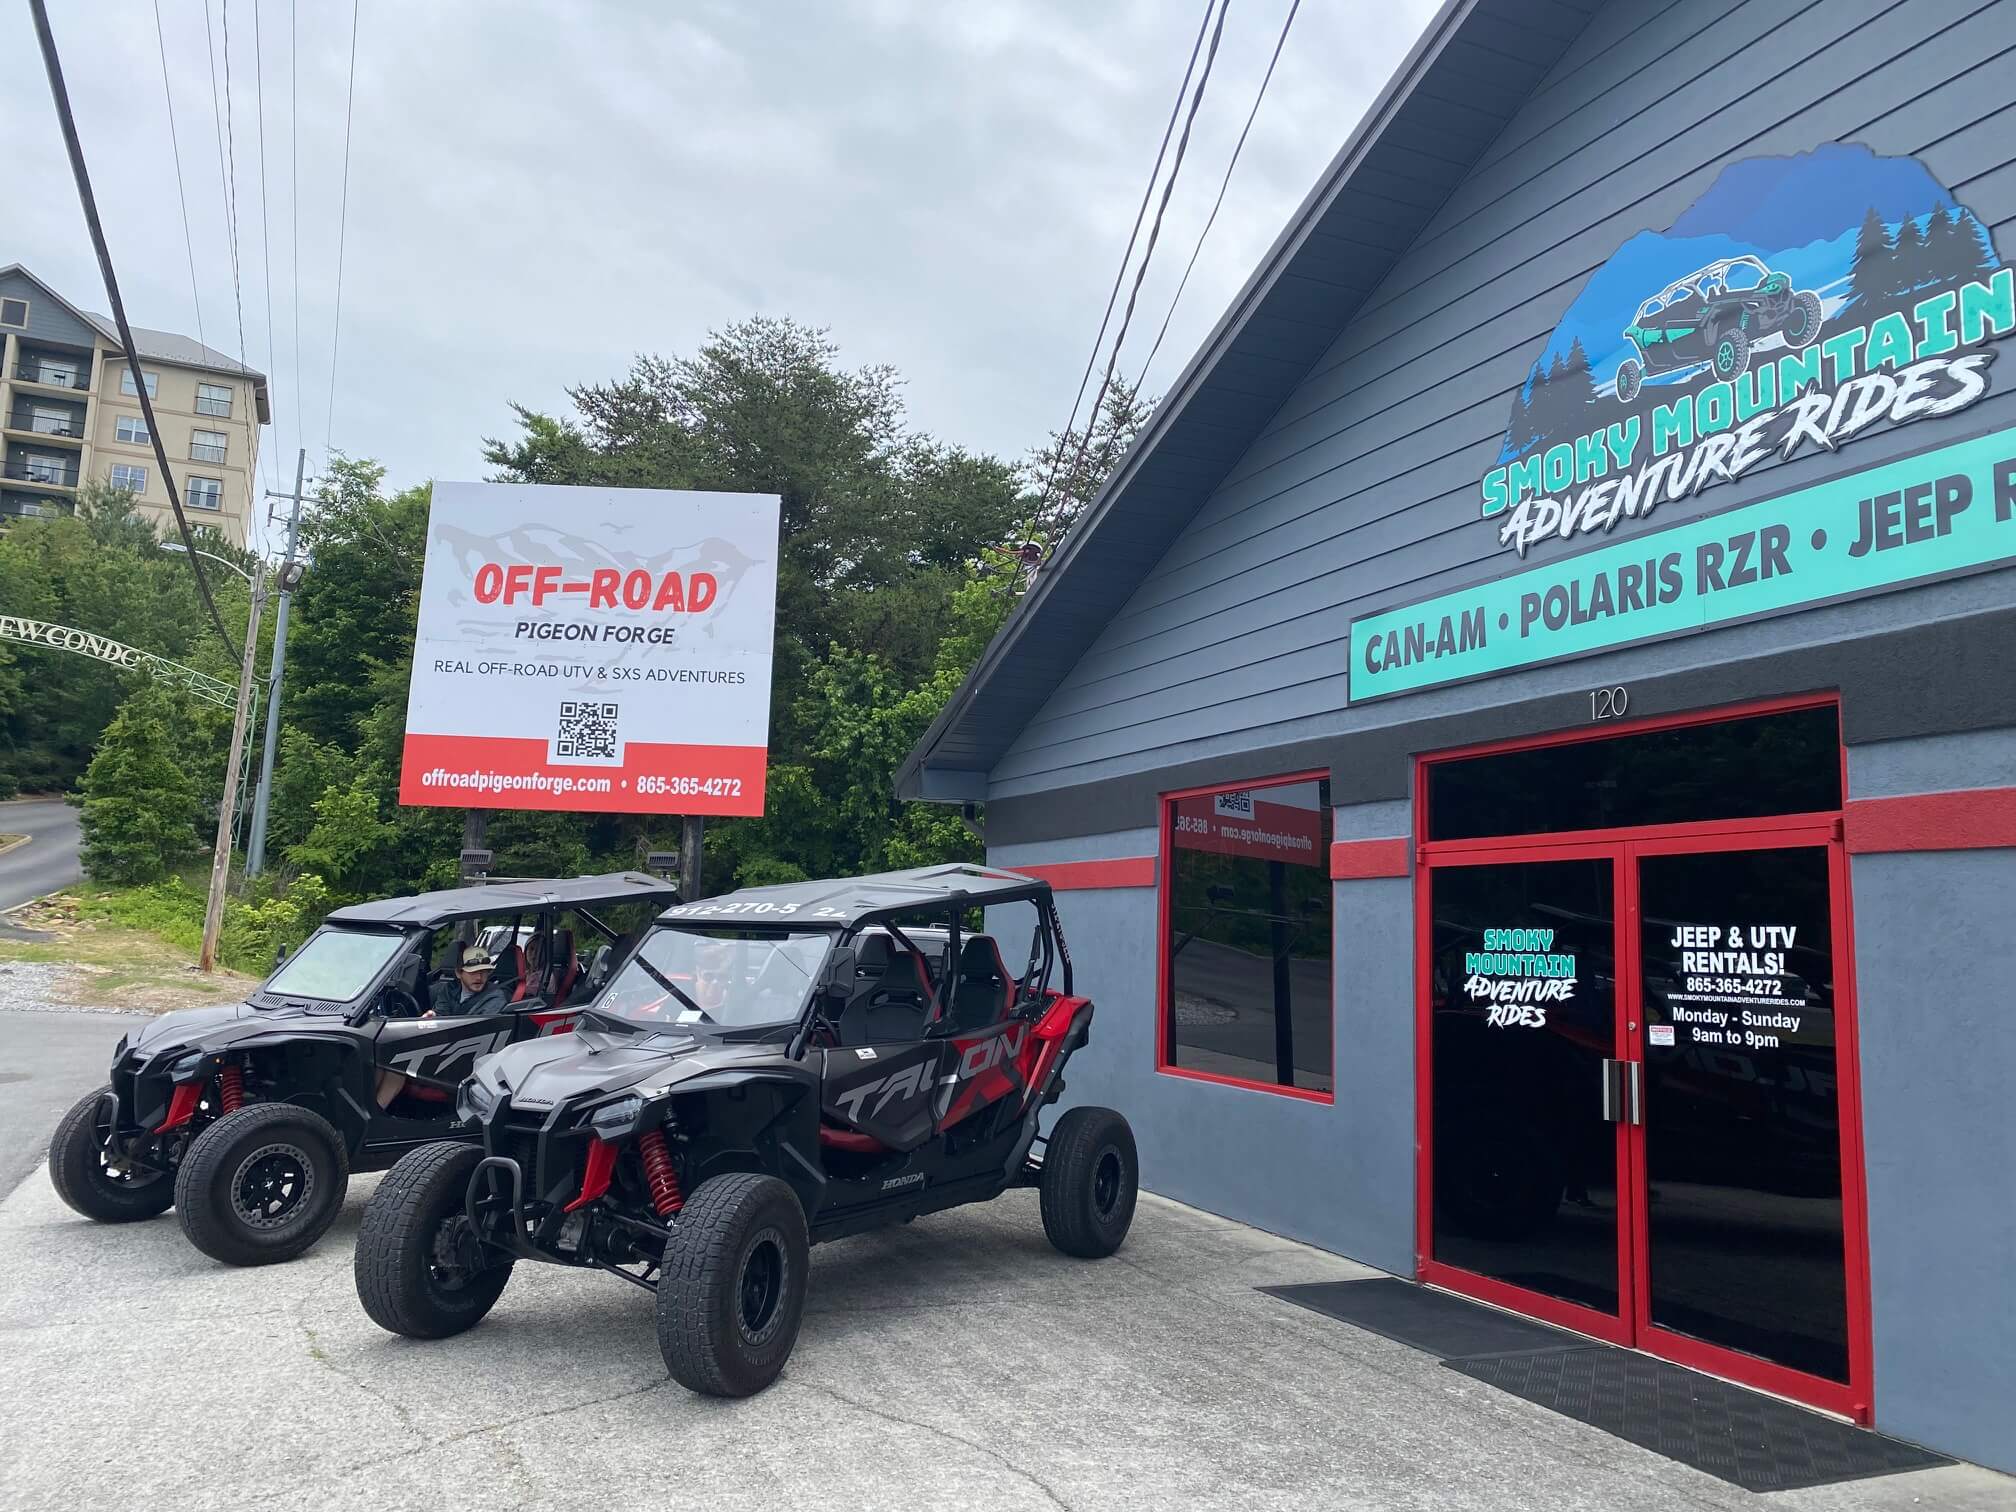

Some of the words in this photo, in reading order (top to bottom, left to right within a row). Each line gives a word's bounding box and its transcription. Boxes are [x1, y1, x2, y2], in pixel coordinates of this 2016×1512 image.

[1482, 416, 1641, 516] SMOKY
[1652, 268, 2015, 456] MOUNTAIN
[1500, 412, 1780, 558] ADVENTURE
[1780, 353, 1993, 460] RIDES
[1364, 606, 1487, 675] CAN-AM
[1521, 552, 1683, 638] POLARIS
[1696, 524, 1793, 595] RZR
[1848, 473, 1974, 558] JEEP
[473, 562, 718, 613] OFF-ROAD
[515, 622, 598, 643] PIGEON
[603, 624, 675, 645] FORGE
[434, 660, 474, 675] REAL
[477, 661, 559, 678] OFF-ROAD
[563, 664, 594, 679] UTV
[597, 665, 608, 680] &
[611, 666, 642, 681] SXS
[645, 667, 746, 685] ADVENTURES
[1588, 686, 1628, 720] 120
[422, 767, 611, 794] offroadpigeonforge.com
[636, 776, 742, 797] 865-365-4272
[1483, 928, 1554, 952] SMOKY
[1671, 926, 1722, 949] JEEP
[1728, 927, 1745, 949] &
[1750, 926, 1797, 949] UTV
[1465, 952, 1576, 978] MOUNTAIN
[1682, 951, 1785, 975] RENTALS!
[1463, 974, 1578, 1004] ADVENTURE
[1686, 977, 1782, 996] 865-365-4272
[1485, 1003, 1547, 1028] RIDES
[1672, 1006, 1729, 1028] Monday
[1741, 1010, 1801, 1032] Sunday
[1692, 1027, 1722, 1045] 9am
[1726, 1028, 1742, 1045] to
[1745, 1030, 1779, 1049] 9pm
[835, 1024, 1024, 1123] TALON
[881, 1172, 925, 1190] HONDA
